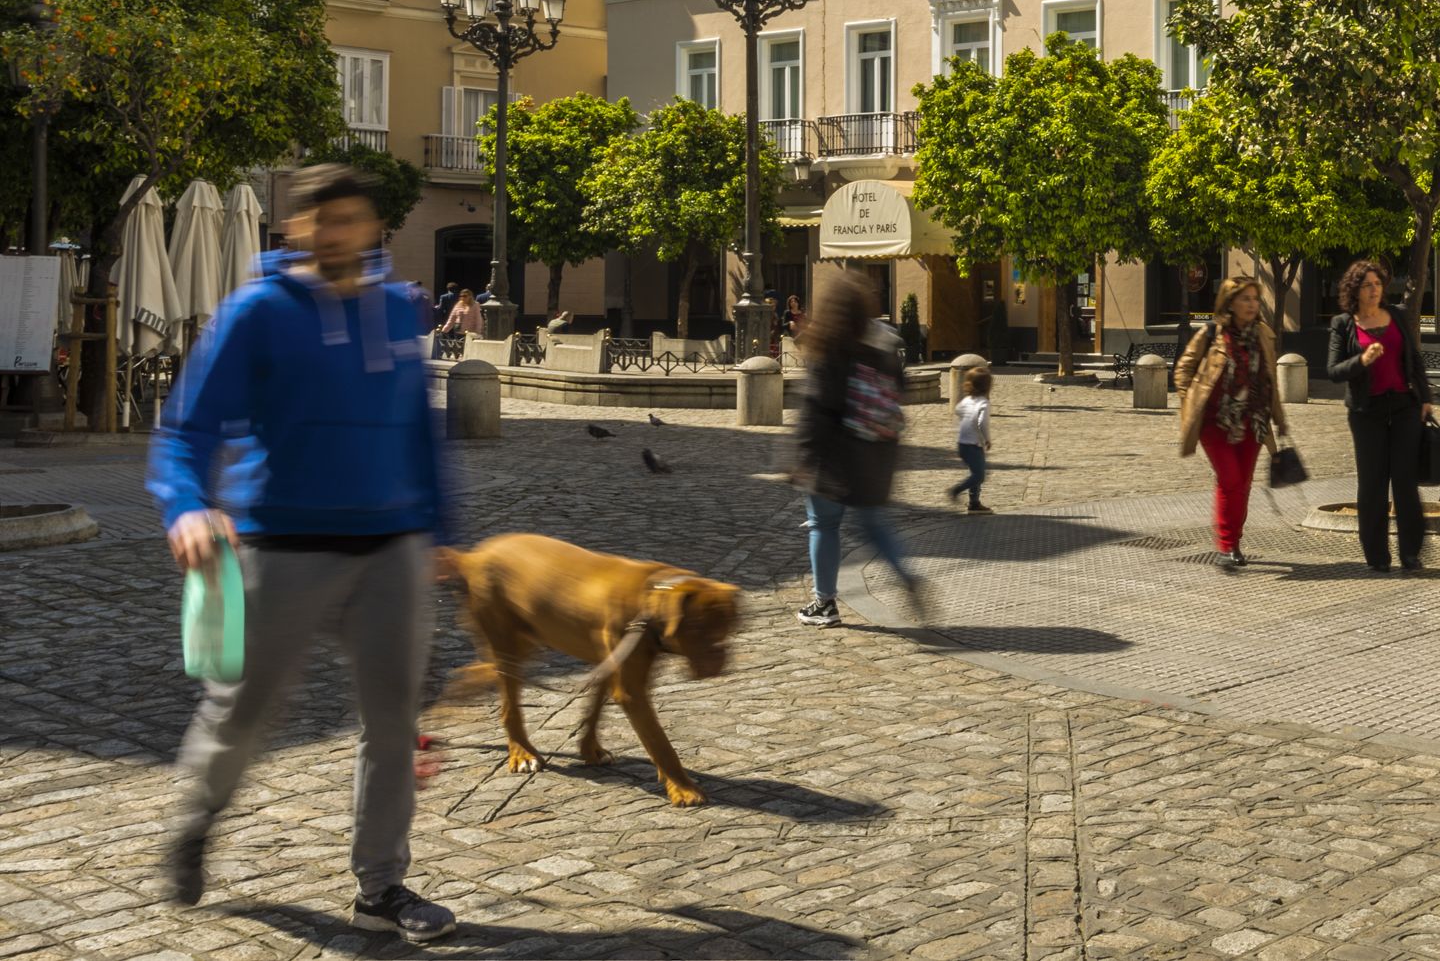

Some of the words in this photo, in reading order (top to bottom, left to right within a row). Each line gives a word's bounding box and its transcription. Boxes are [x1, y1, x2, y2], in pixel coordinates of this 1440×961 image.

[852, 192, 877, 203] HOTEL
[859, 208, 870, 219] DE
[833, 224, 867, 235] FRANCIA
[869, 224, 875, 234] Y
